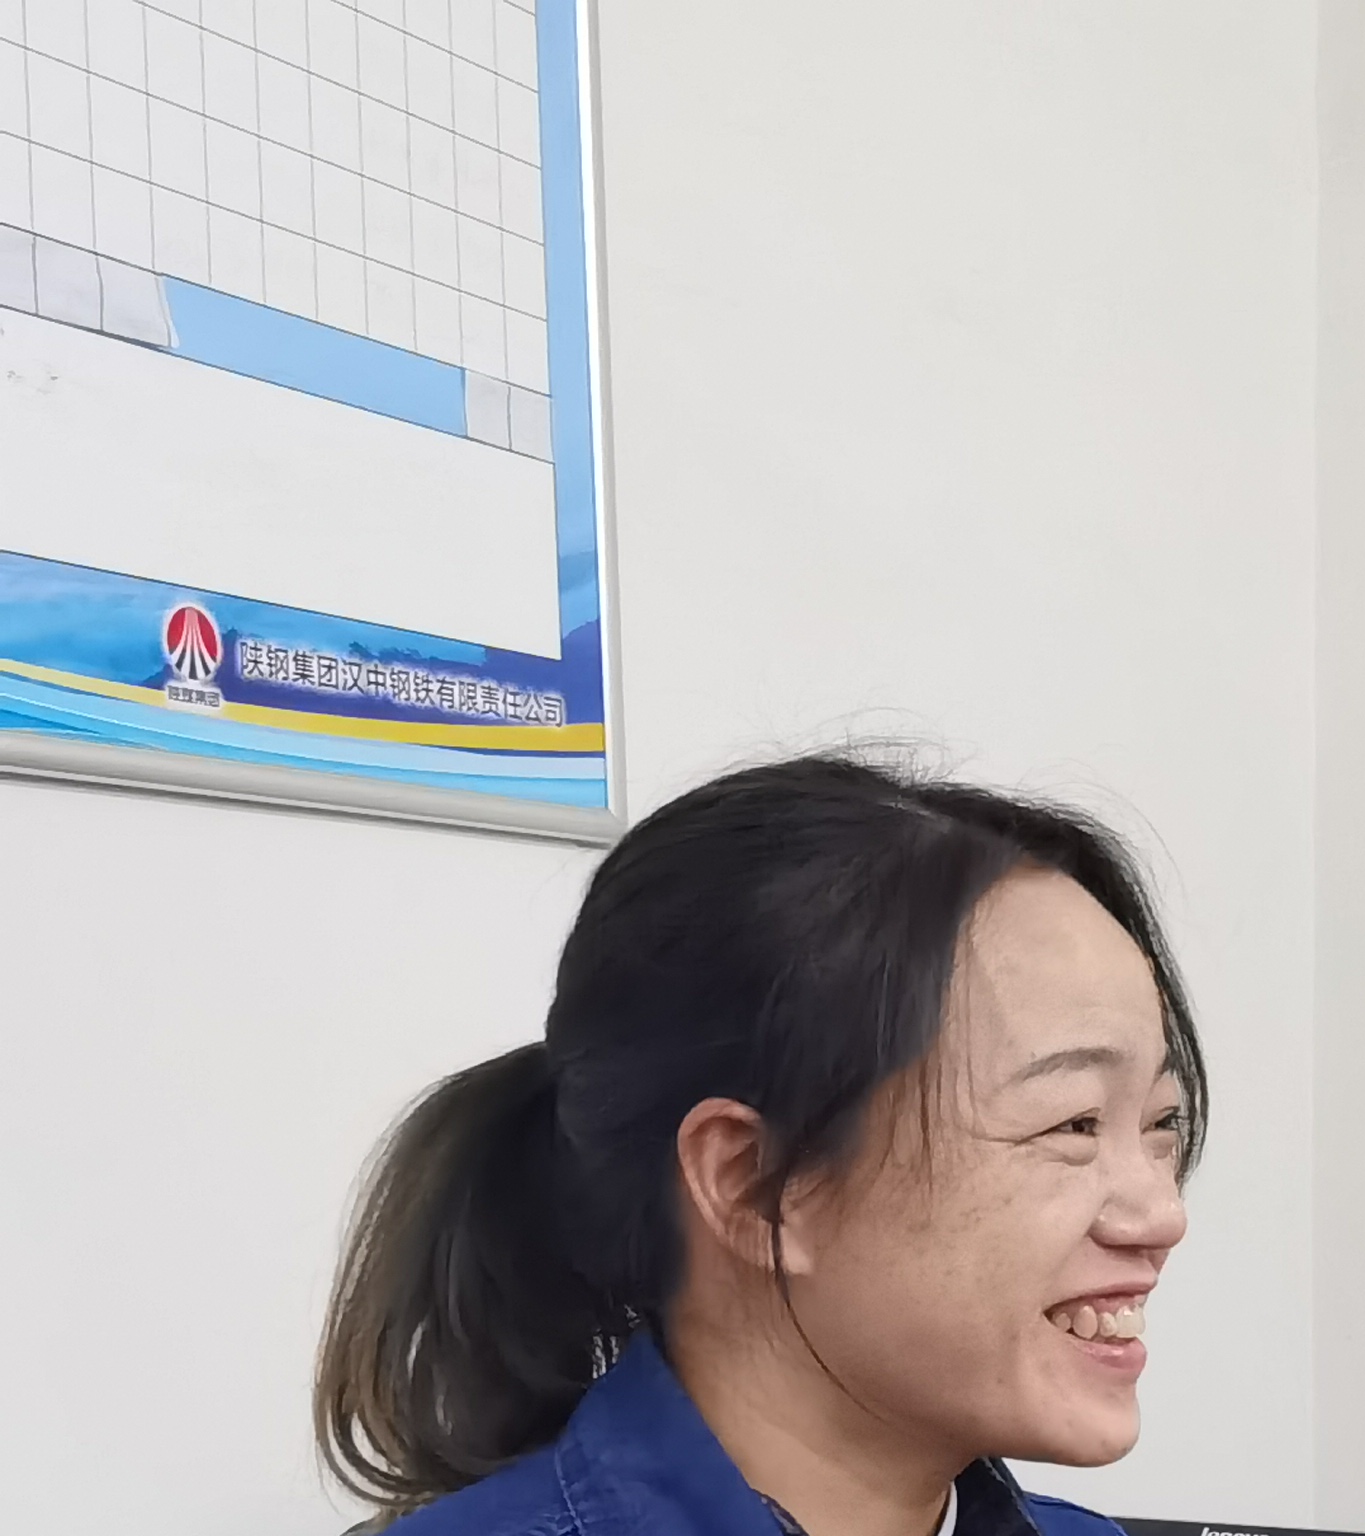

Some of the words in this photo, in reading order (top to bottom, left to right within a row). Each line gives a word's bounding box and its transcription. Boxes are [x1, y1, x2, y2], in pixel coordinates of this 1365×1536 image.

[239, 640, 565, 729] 陕钢集团汉中钢铁有限责任公司
